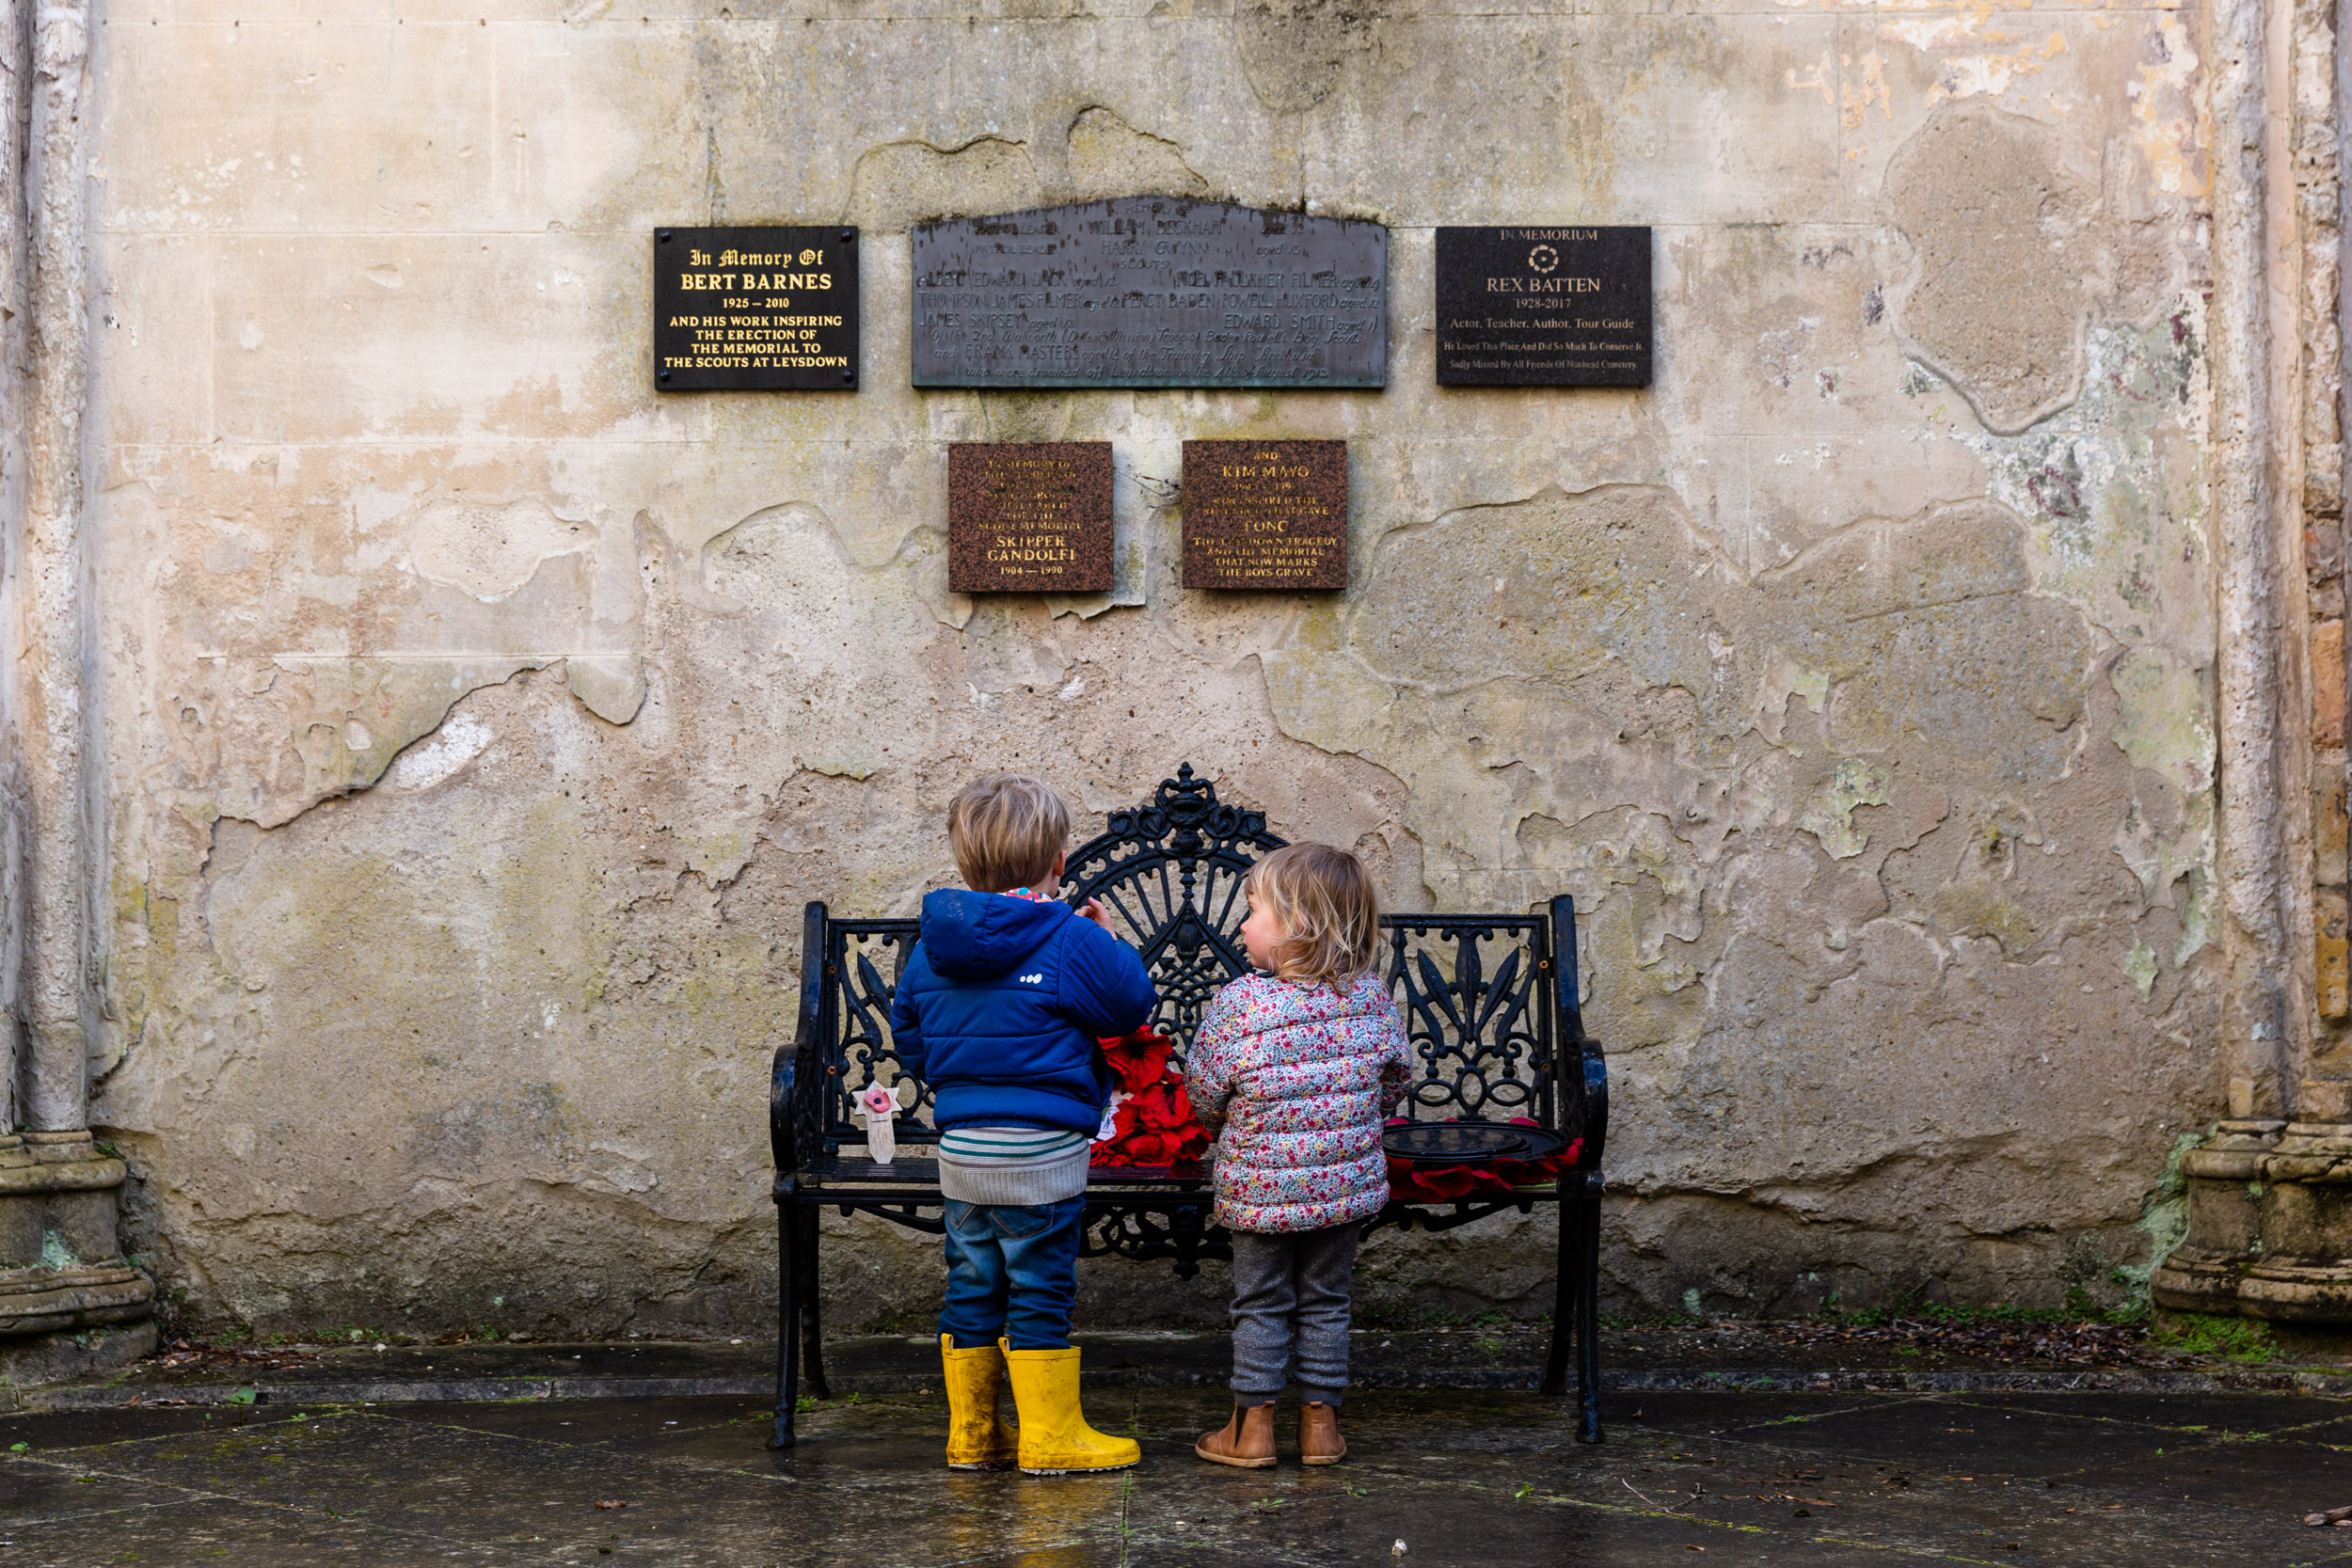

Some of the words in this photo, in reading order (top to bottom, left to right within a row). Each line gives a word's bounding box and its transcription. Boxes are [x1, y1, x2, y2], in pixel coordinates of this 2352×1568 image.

[1125, 204, 1172, 214] MEMORY
[1020, 224, 1060, 234] LEADER
[1088, 218, 1145, 235] WILLIAM
[1156, 220, 1222, 235] BECKHAM
[1501, 230, 1515, 240] IN
[1518, 230, 1597, 240] MEMORIUM
[974, 244, 1016, 254] PATROL
[1020, 244, 1059, 255] LEADER
[1101, 241, 1146, 255] HARRY
[1154, 241, 1209, 255] GWYNN
[1257, 245, 1283, 257] aged
[690, 249, 711, 266] In
[719, 249, 792, 268] Memory
[800, 248, 823, 265] Of
[1121, 259, 1168, 270] SCOUTS
[681, 274, 736, 290] BERT
[742, 274, 832, 290] BARNES
[973, 271, 1025, 287] EDWARD
[1073, 274, 1098, 290] aged
[1105, 274, 1116, 287] 12
[1177, 271, 1210, 287] NOEL
[1215, 271, 1284, 288] FAULKNER
[1292, 271, 1338, 288] FILMER
[1487, 278, 1523, 293] REX
[1530, 278, 1600, 293] BATTEN
[723, 298, 749, 309] 1925
[766, 298, 789, 308] 2010
[918, 293, 987, 308] THOMPSON
[993, 293, 1034, 309] JAMES
[1037, 293, 1082, 309] FILMER
[1083, 298, 1109, 311] aged
[1121, 293, 1165, 309] PERCY
[1168, 293, 1215, 309] BADEN
[1222, 293, 1272, 309] POWELL
[1276, 293, 1338, 309] HUXFORD
[1340, 297, 1366, 310] aged
[1369, 297, 1378, 309] 12
[1516, 299, 1571, 309] 1928-2017
[670, 316, 698, 326] AND
[703, 316, 725, 326] HIS
[730, 316, 770, 326] WORK
[774, 316, 842, 326] INSPIRING
[919, 312, 961, 327] JAMES
[969, 312, 1023, 328] SKIPSEY
[1029, 316, 1057, 331] aged
[1224, 314, 1281, 328] EDWARD
[1291, 314, 1335, 329] SMITH
[1336, 320, 1366, 334] aged
[1575, 319, 1598, 328] Tour
[1602, 319, 1634, 329] Guide
[695, 330, 723, 340] THE
[728, 330, 795, 340] ERECTION
[800, 329, 817, 340] OF
[931, 329, 944, 344] Of
[948, 330, 967, 341] the
[1158, 328, 1186, 344] Troop
[1189, 330, 1200, 343] of
[1293, 331, 1319, 348] Boy
[1324, 331, 1362, 345] Scouts
[691, 343, 719, 354] THE
[723, 343, 799, 354] MEMORIAL
[803, 343, 820, 353] TO
[1444, 342, 1454, 351] He
[1457, 342, 1480, 351] Loved
[1482, 342, 1498, 351] This
[1521, 342, 1536, 351] And
[1538, 341, 1551, 351] Did
[1554, 342, 1564, 351] So
[1565, 341, 1586, 351] Much
[1588, 342, 1597, 351] To
[1599, 342, 1632, 351] Conserve
[934, 346, 957, 358] and
[966, 344, 1013, 359] FRANK
[1019, 344, 1078, 359] MASTERS
[1082, 346, 1109, 363] aged
[1123, 346, 1136, 361] of
[1138, 347, 1156, 361] the
[1159, 346, 1211, 363] Training
[1217, 345, 1246, 362] Ship
[664, 357, 691, 367] THE
[696, 357, 749, 367] SCOUTS
[753, 357, 768, 367] AT
[772, 356, 847, 367] LEYSDOWN
[1450, 360, 1470, 371] Sadly
[1501, 361, 1510, 371] By
[1567, 360, 1598, 369] Nunhead
[966, 368, 991, 377] who
[995, 369, 1024, 377] were
[1028, 367, 1080, 377] drowned
[1088, 365, 1105, 380] off
[1195, 366, 1211, 377] the
[1243, 366, 1256, 380] of
[1257, 365, 1300, 380] August
[1302, 368, 1328, 380] 1912
[1223, 466, 1255, 477] KIM
[1263, 466, 1309, 477] MAYO
[996, 536, 1065, 547] SKIPPER
[987, 549, 1074, 561] GANDOLFI
[1276, 558, 1317, 566] MARKS
[1041, 566, 1062, 575] 1990
